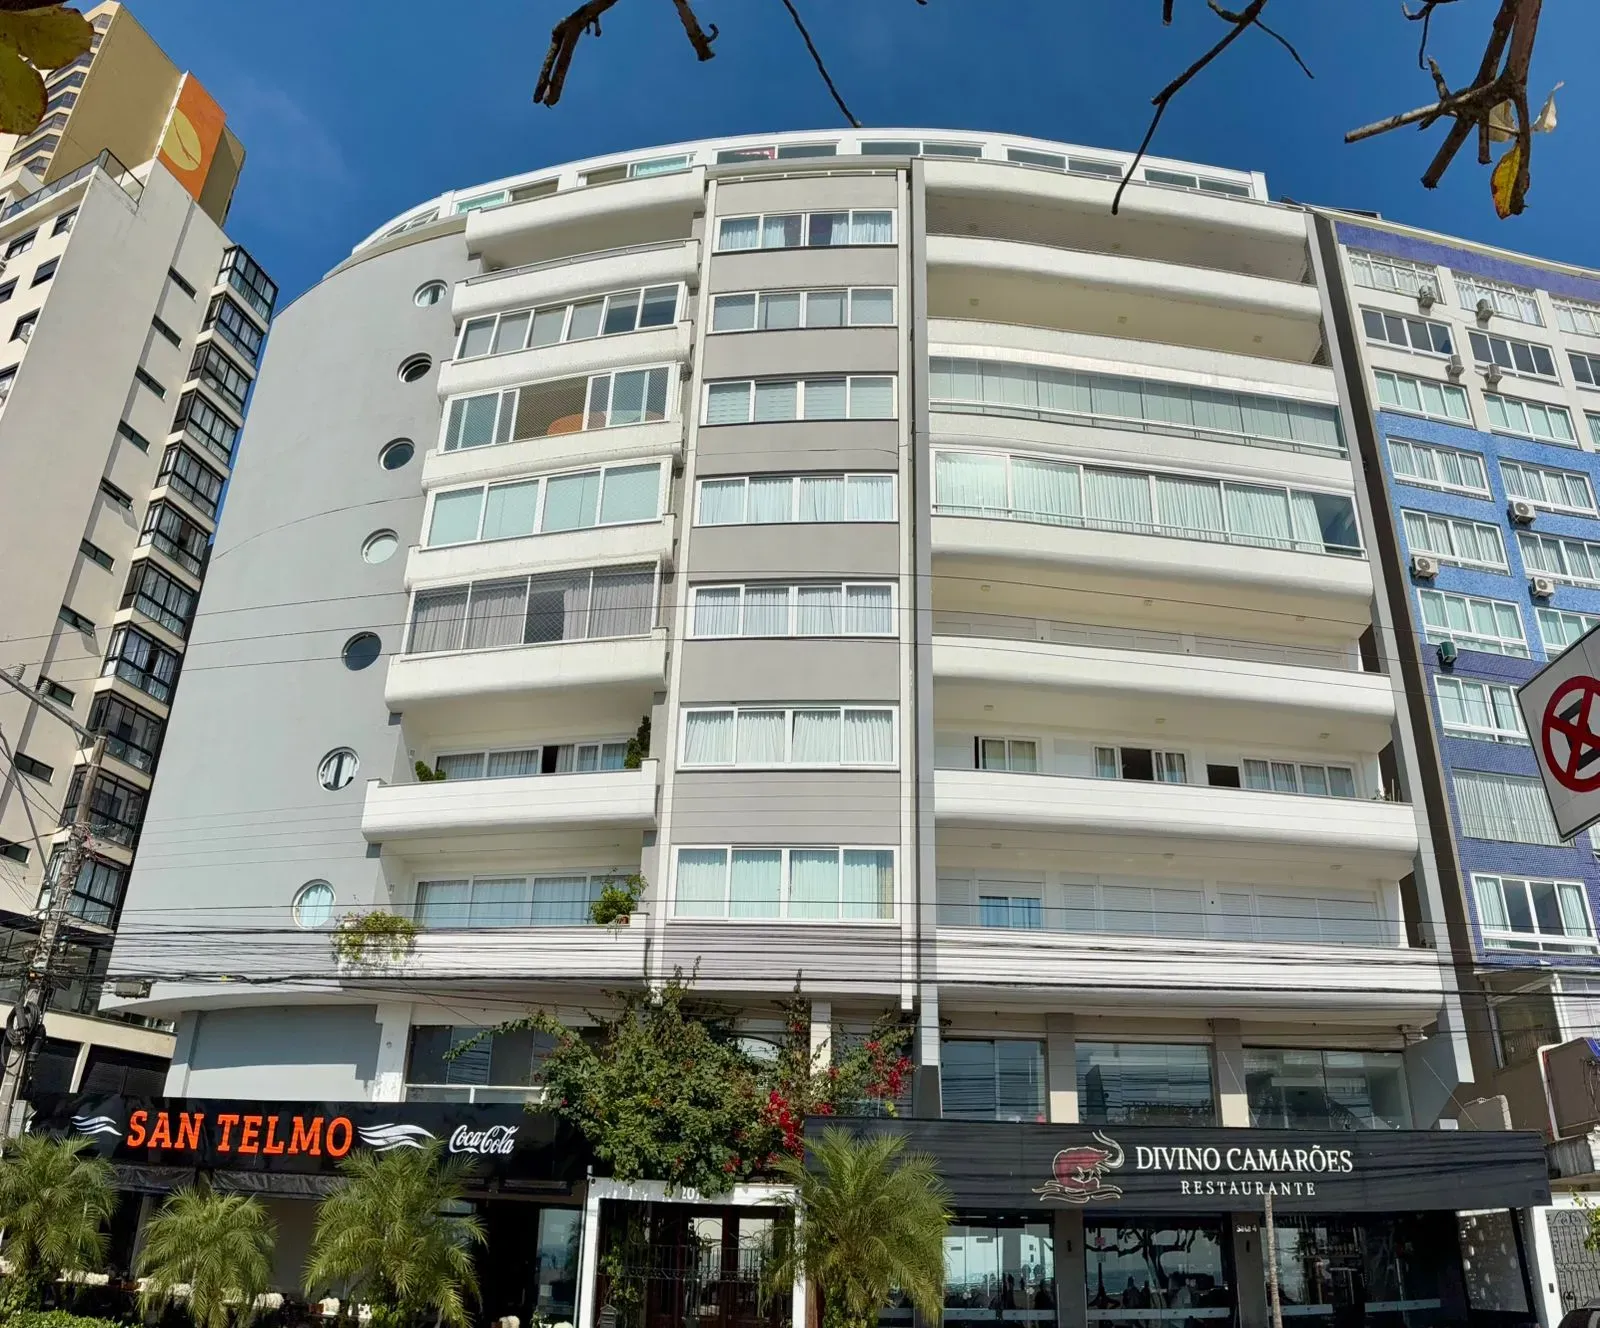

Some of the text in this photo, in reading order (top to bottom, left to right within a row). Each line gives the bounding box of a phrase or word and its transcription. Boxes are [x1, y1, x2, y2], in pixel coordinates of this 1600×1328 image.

[127, 1110, 353, 1157] SAN TELMO
[449, 1124, 520, 1154] Coca-Cola
[1135, 1145, 1353, 1173] DIVINO CAMARÕES
[1181, 1180, 1316, 1196] RESTAURANTE
